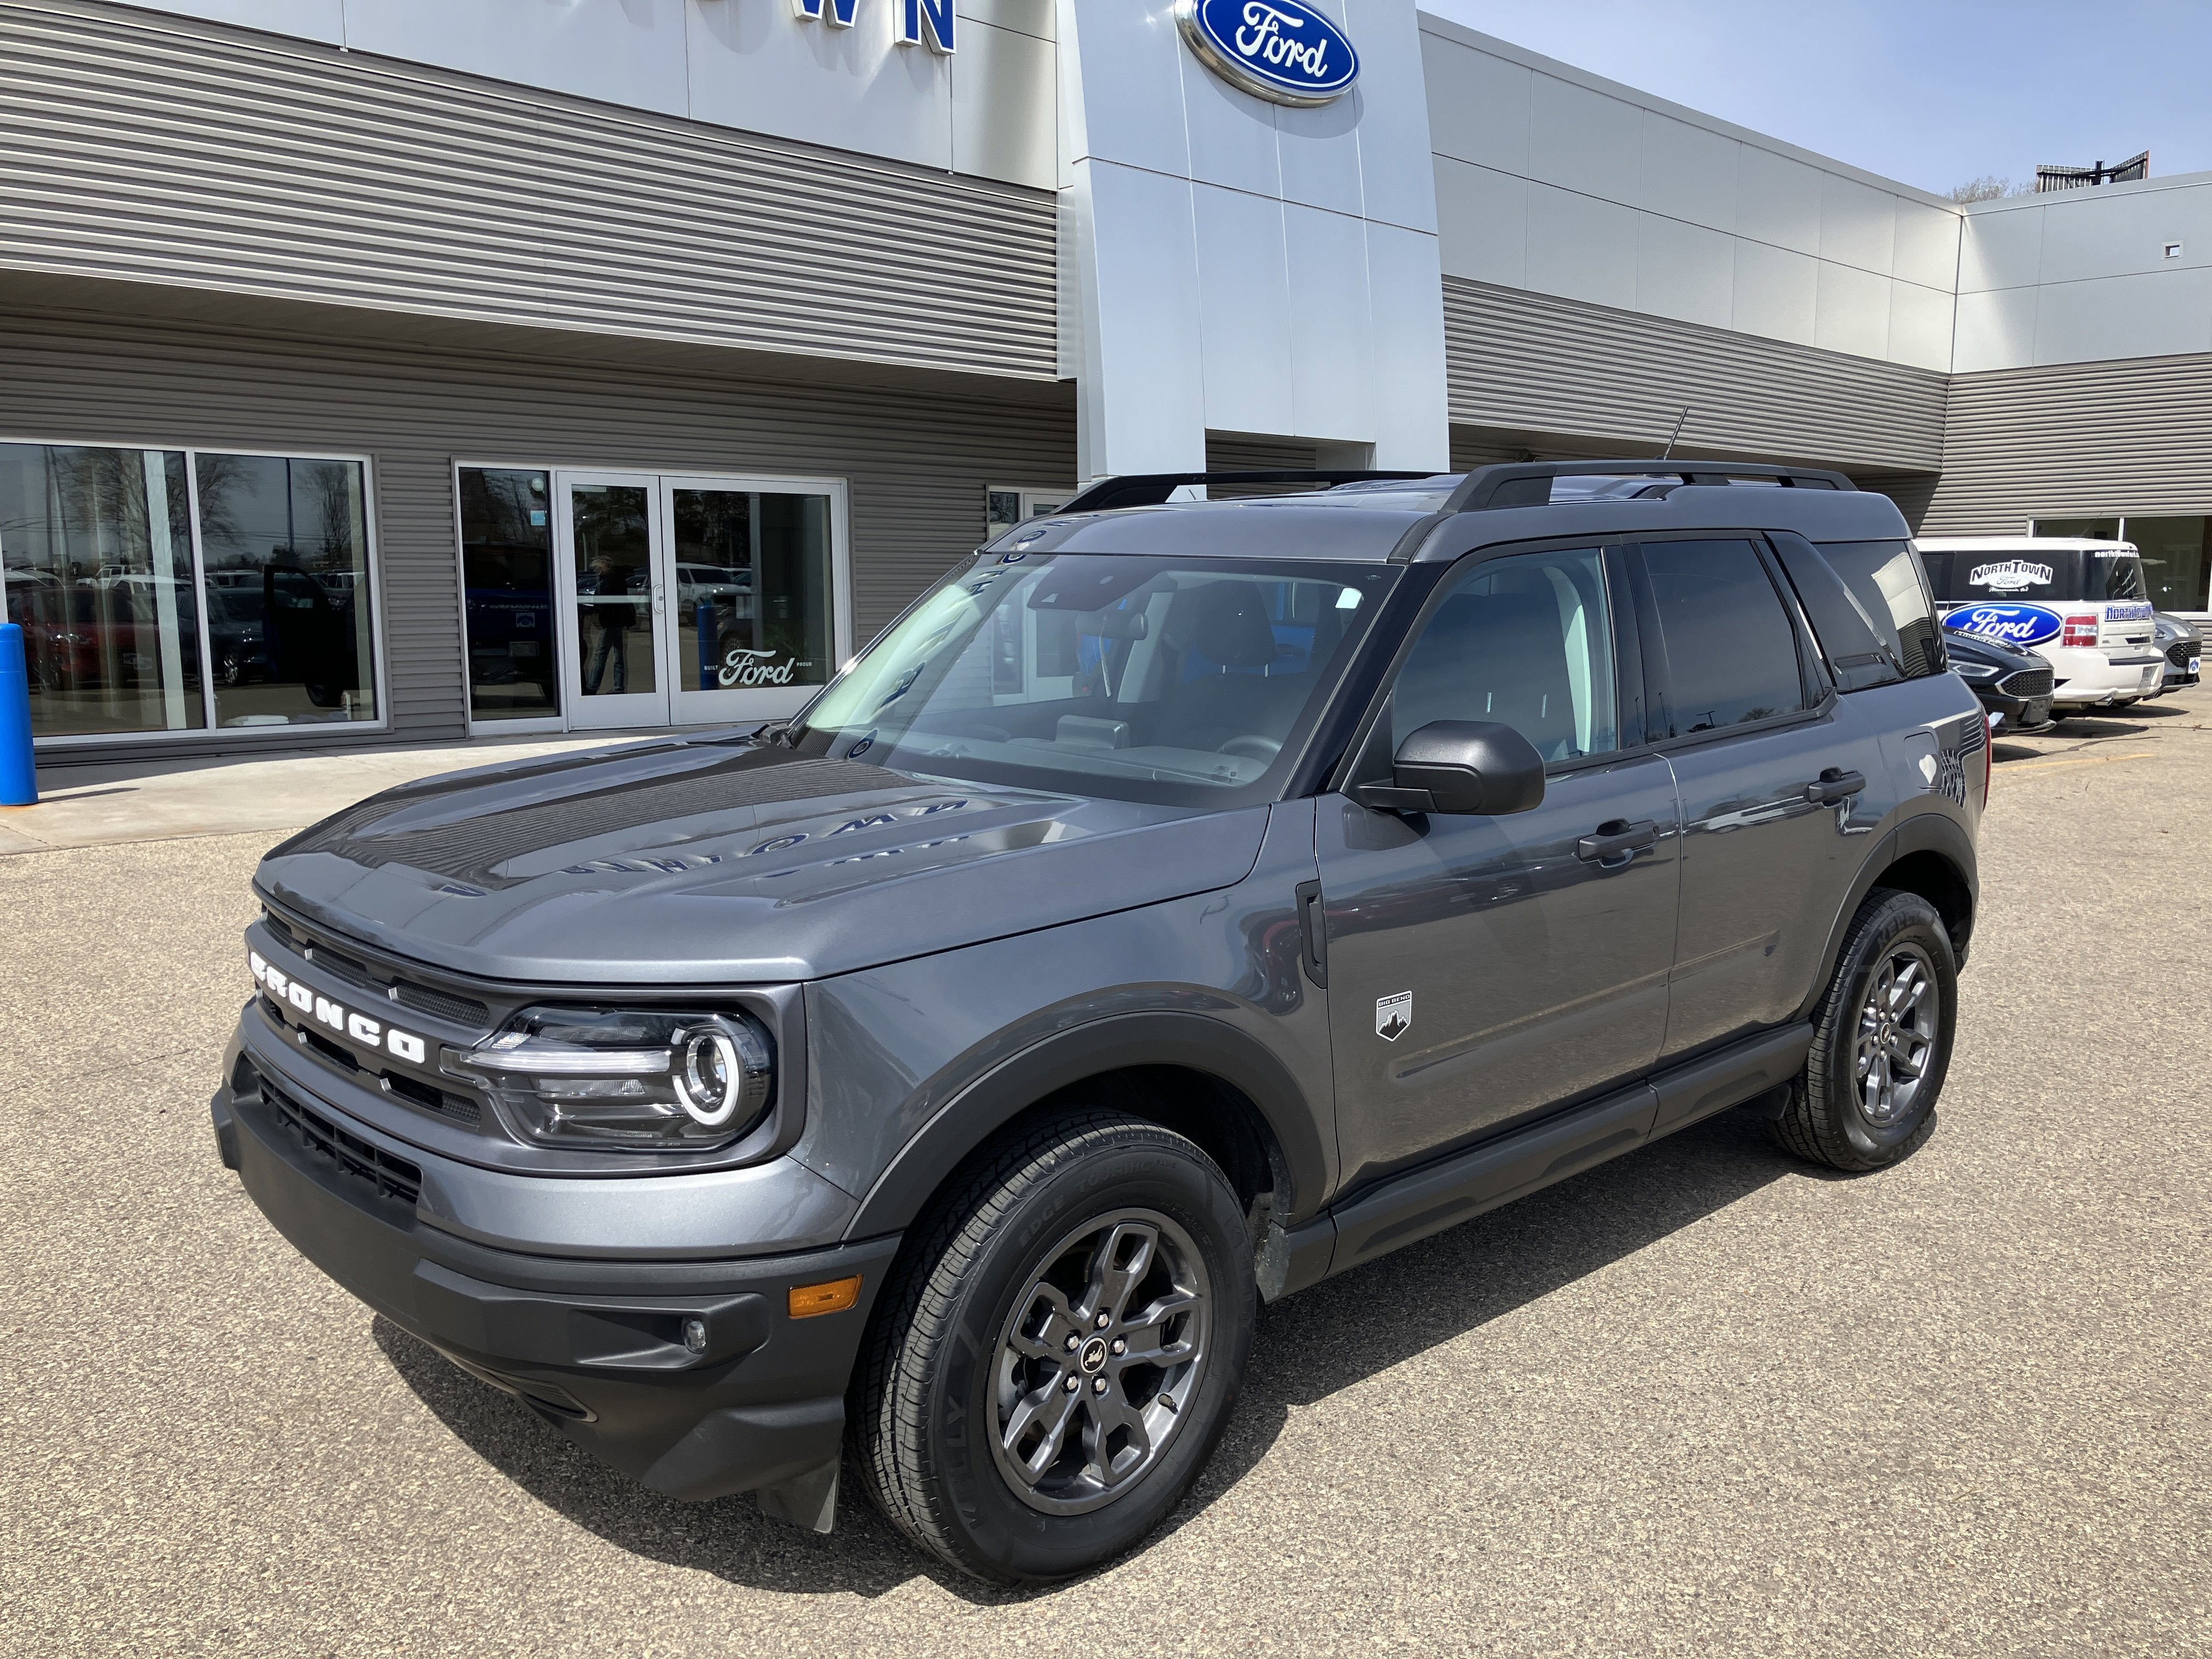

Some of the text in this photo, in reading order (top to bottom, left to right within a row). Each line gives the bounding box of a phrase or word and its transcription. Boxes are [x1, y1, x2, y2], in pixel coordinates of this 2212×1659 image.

[1235, 1, 1328, 77] Ford
[1996, 577, 2022, 585] Ford
[1963, 608, 2038, 638] Ford
[718, 649, 795, 686] Ford
[250, 951, 425, 1064] BRONCO
[1391, 994, 1410, 1003] BEND
